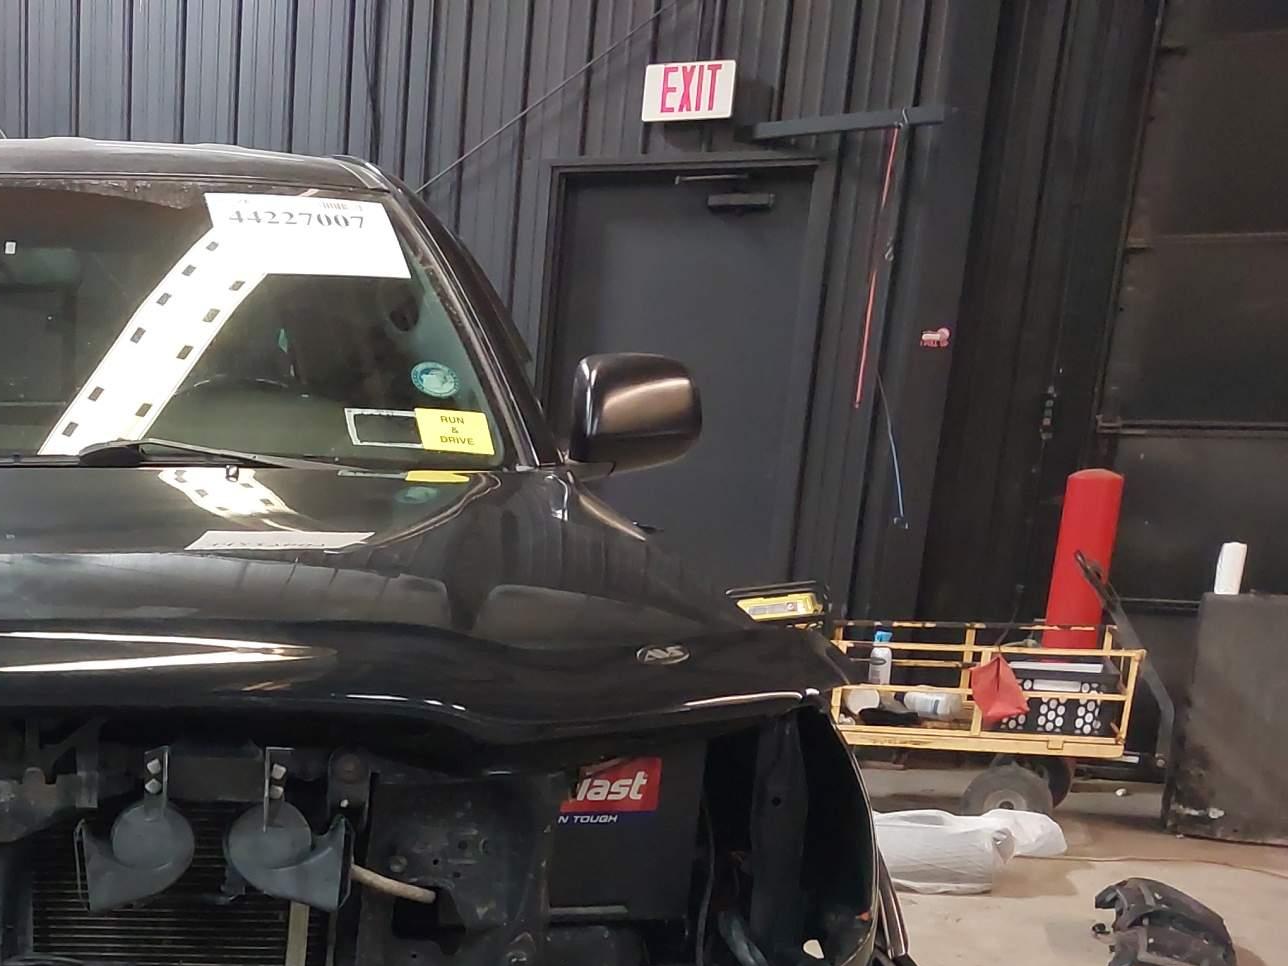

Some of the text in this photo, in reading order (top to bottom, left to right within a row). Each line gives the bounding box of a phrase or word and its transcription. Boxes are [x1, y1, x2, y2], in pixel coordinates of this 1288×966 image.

[660, 64, 722, 112] EXIT
[229, 210, 364, 229] 44227007
[440, 415, 465, 425] RUN
[440, 435, 475, 446] DRIVE
[576, 771, 648, 801] last
[574, 815, 618, 824] TOUGH
